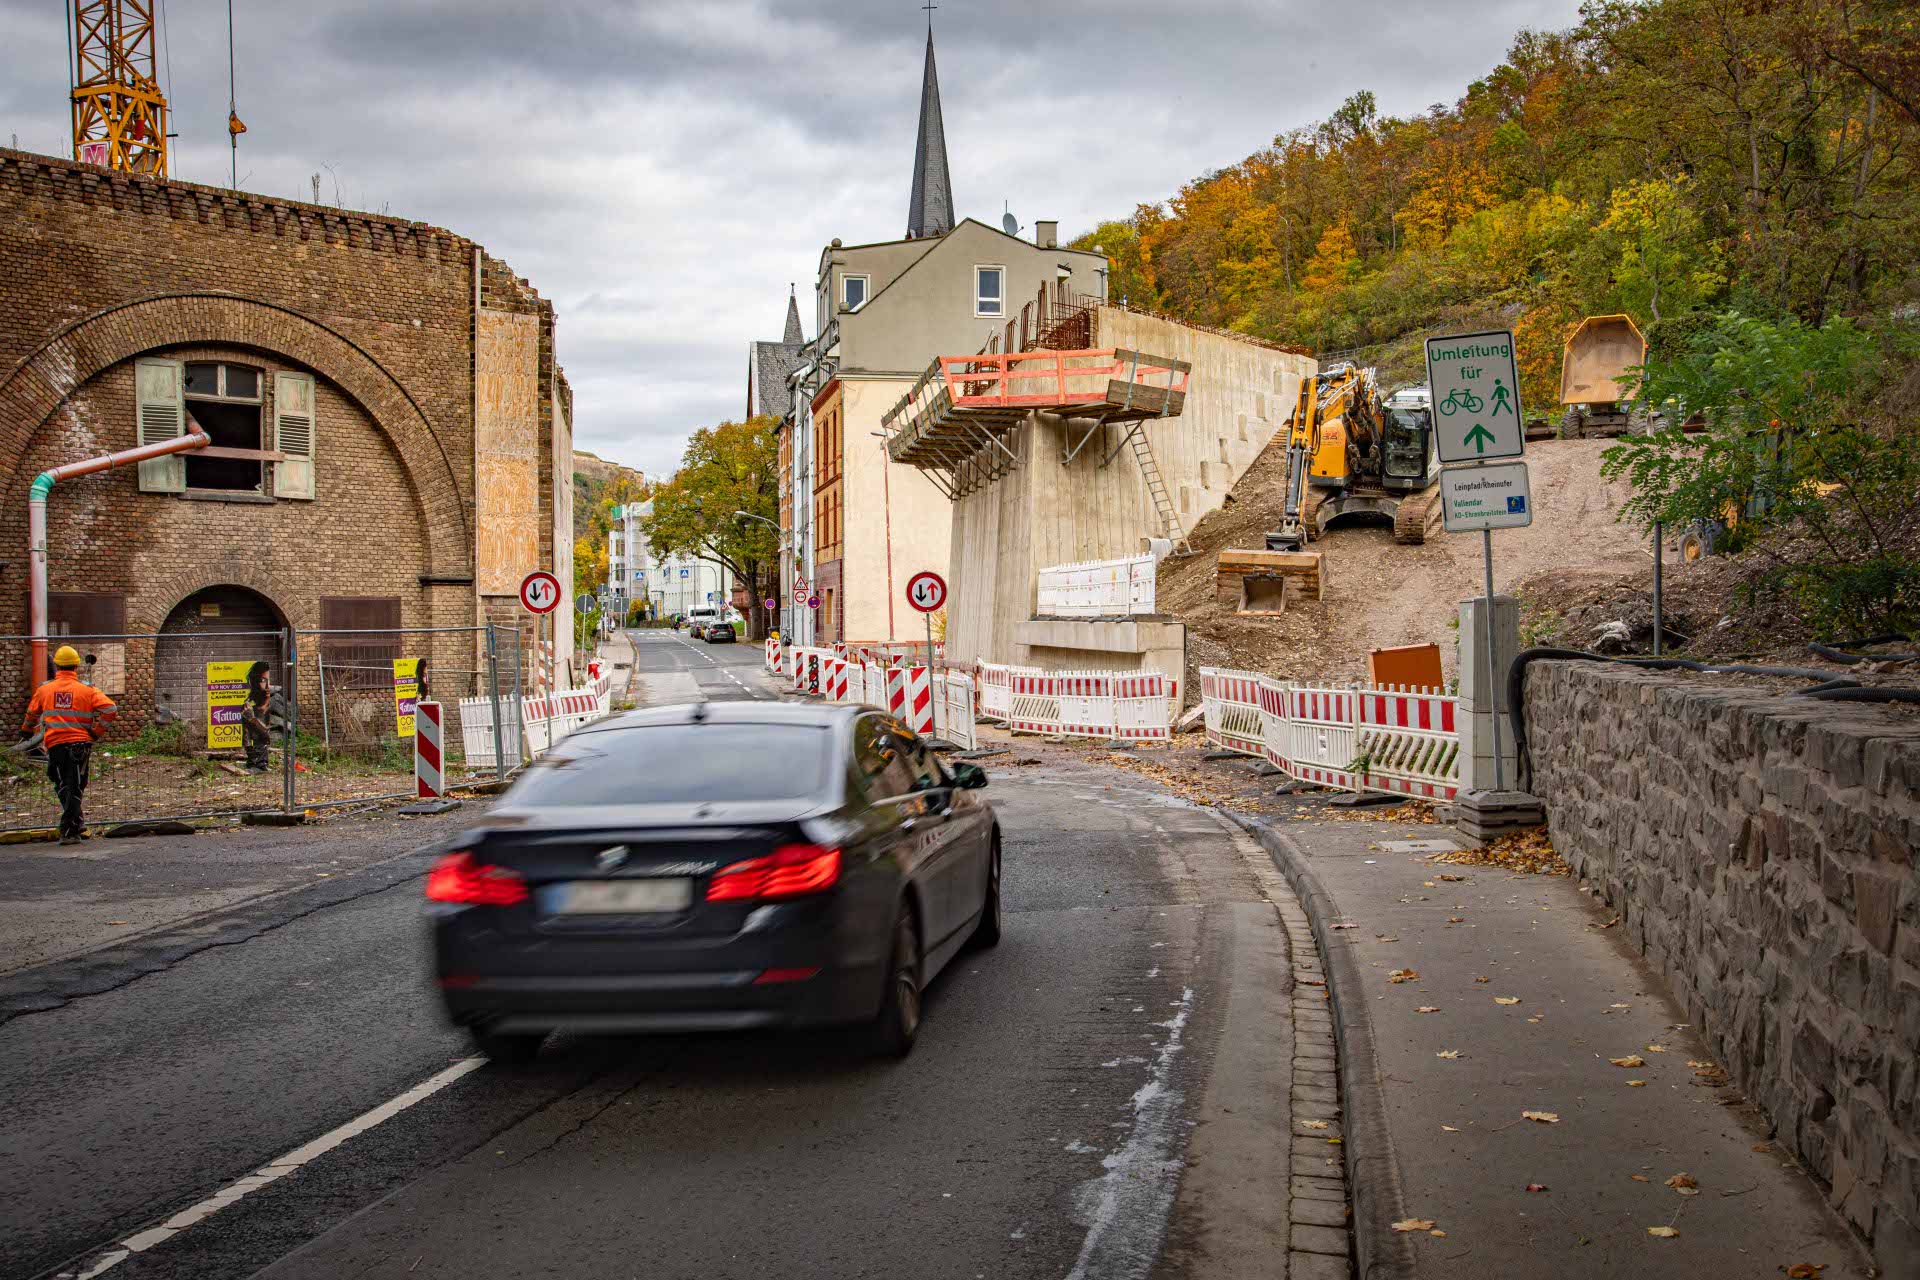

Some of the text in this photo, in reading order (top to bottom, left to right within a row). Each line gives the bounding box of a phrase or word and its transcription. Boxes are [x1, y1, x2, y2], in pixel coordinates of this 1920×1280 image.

[1431, 344, 1509, 361] Umleitung
[1460, 366, 1482, 379] für
[1454, 480, 1512, 491] Leinpfad/Rheinufer
[1453, 499, 1483, 507] Vallendar
[213, 707, 242, 723] Tattoo
[213, 725, 241, 736] CON
